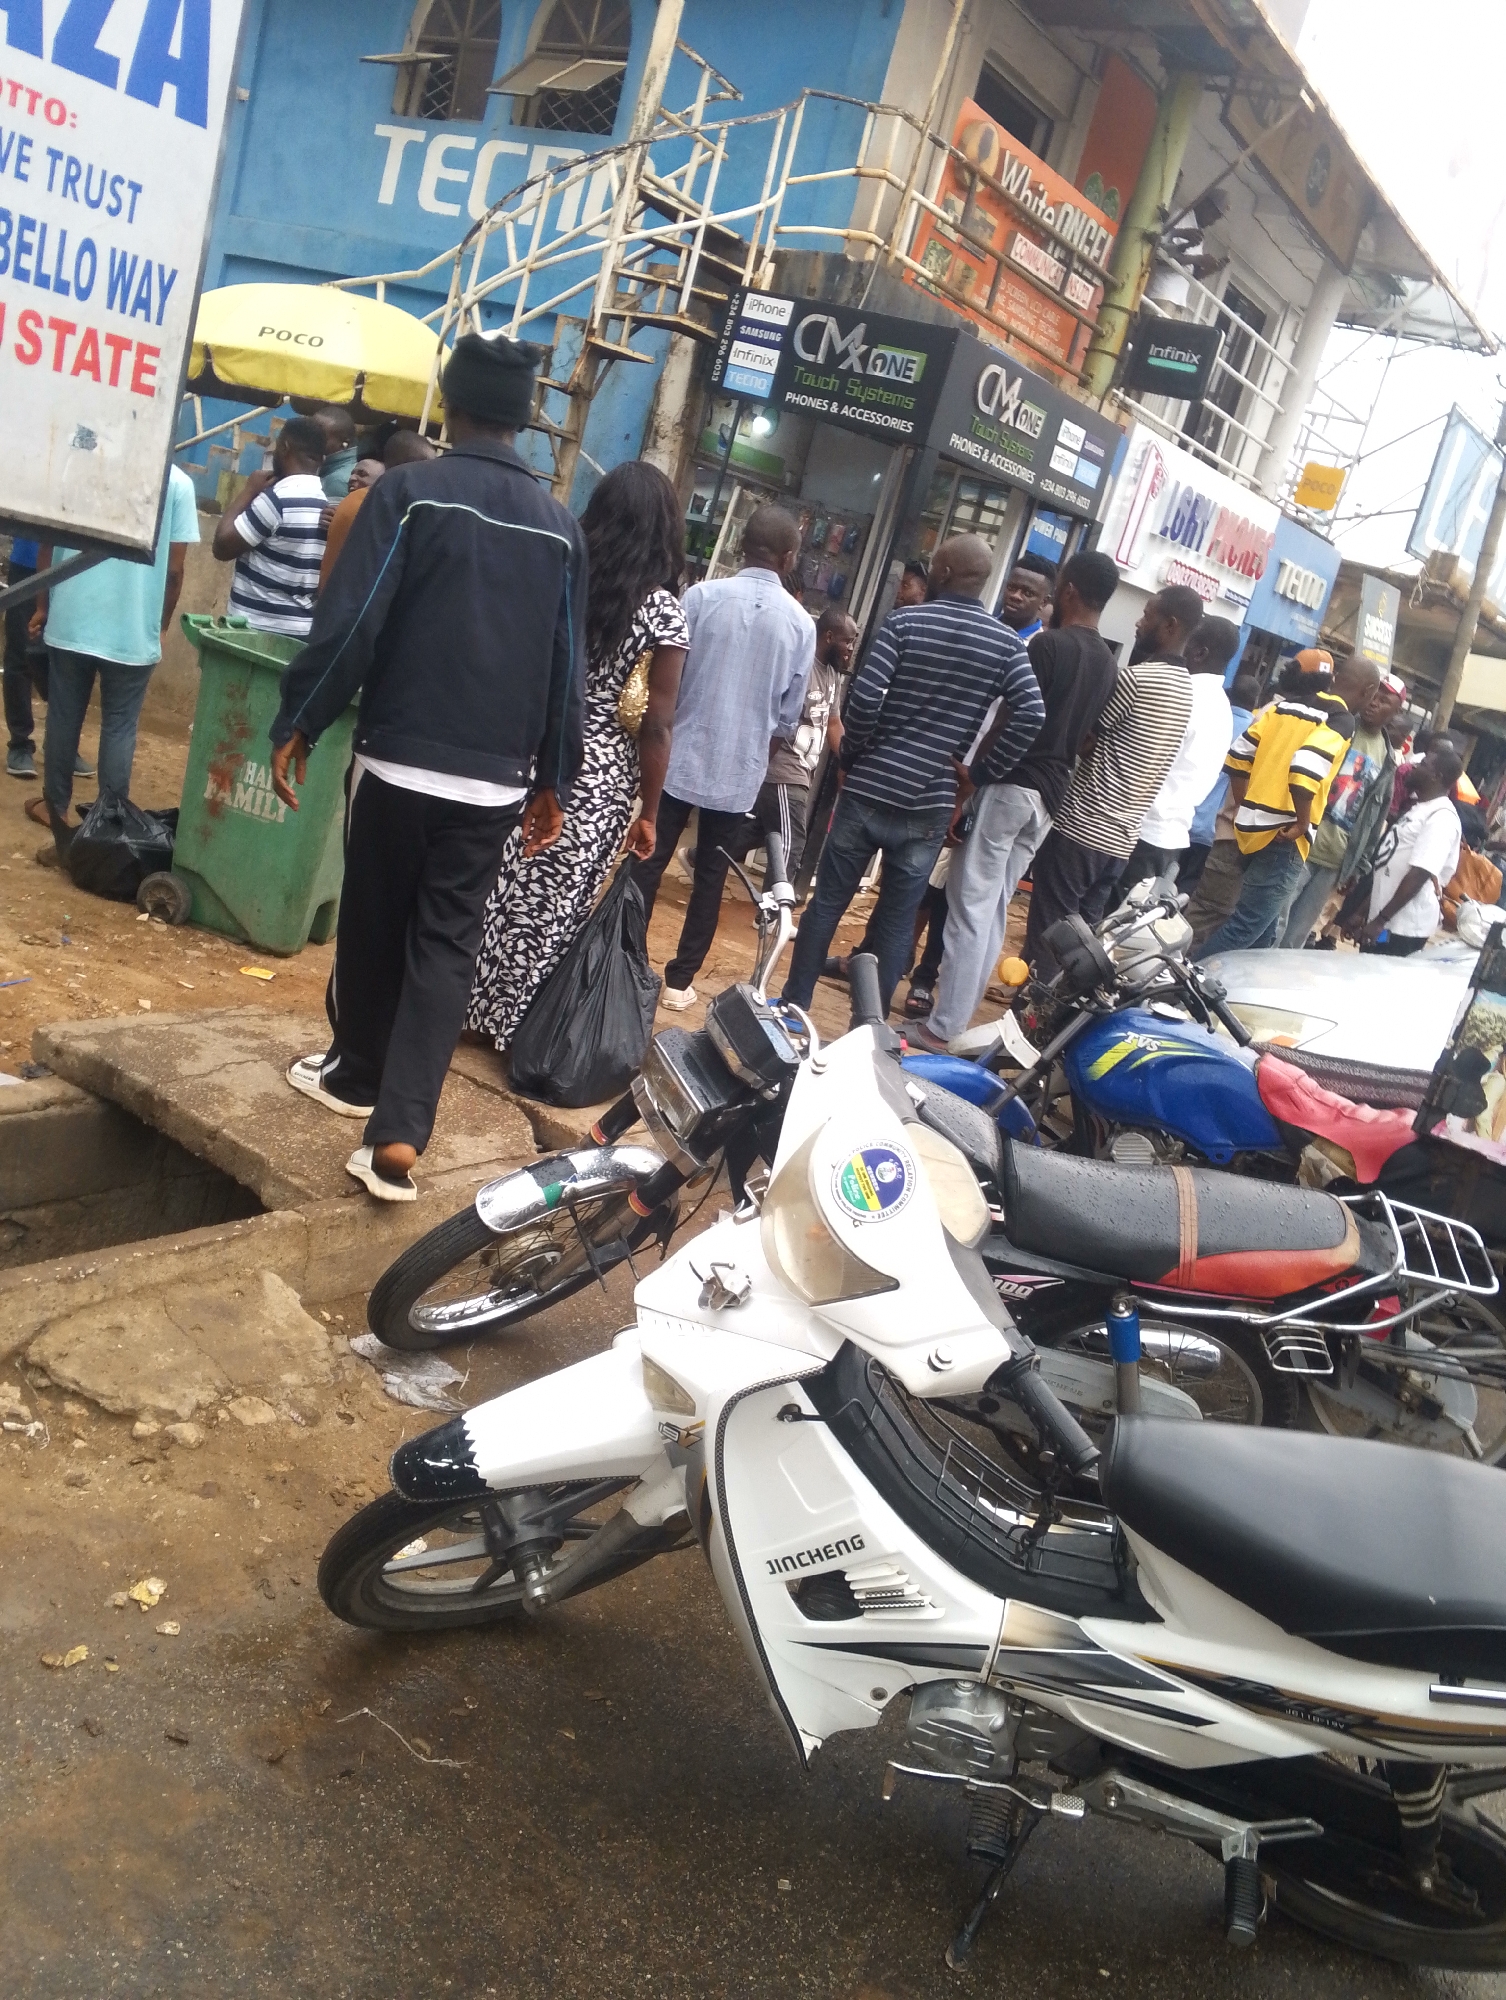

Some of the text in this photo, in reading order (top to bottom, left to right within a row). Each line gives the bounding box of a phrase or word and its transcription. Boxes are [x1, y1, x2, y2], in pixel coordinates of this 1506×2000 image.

[46, 146, 142, 225] TRUST
[107, 247, 178, 327] WAY
[748, 298, 787, 318] iPhone
[14, 309, 162, 398] STATE
[258, 326, 324, 348] POCO
[740, 325, 783, 342] SAMSUNG
[729, 371, 768, 391] TECNO
[794, 365, 917, 410] Touch Systems
[785, 391, 915, 433] PHONES & ACCESSORIES
[949, 433, 1037, 485] PHONES & ACCESSORIES
[971, 414, 1034, 463] Touch Systems
[1302, 477, 1337, 496] POCO
[1275, 557, 1327, 610] TECNO
[1123, 1031, 1161, 1051] TVS
[765, 1534, 866, 1575] JINCHENG
